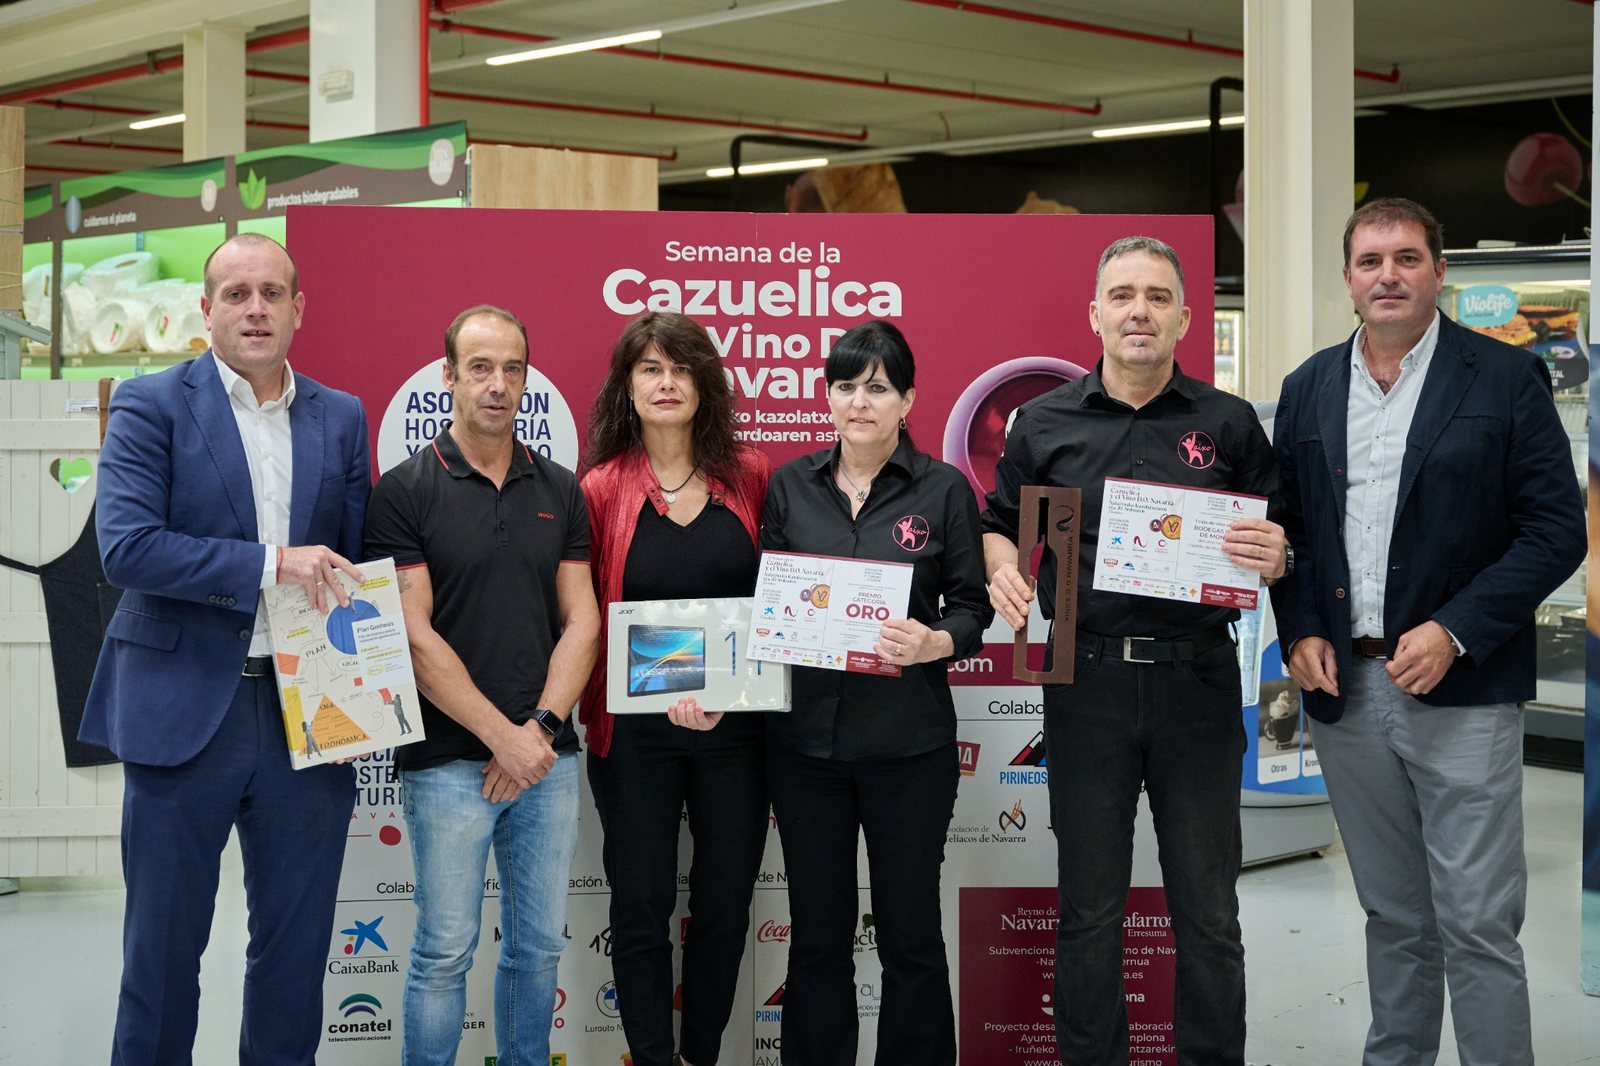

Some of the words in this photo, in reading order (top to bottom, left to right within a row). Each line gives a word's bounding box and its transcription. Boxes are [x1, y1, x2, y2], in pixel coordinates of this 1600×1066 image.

[302, 185, 359, 205] biodegradables
[665, 240, 772, 263] Semana
[779, 241, 813, 263] de
[820, 241, 841, 263] la
[602, 265, 903, 318] Cazuelica
[1464, 293, 1514, 317] Violife
[704, 322, 811, 359] Vino
[733, 428, 812, 442] ardoaren
[1194, 525, 1225, 535] BODEGAS
[1209, 533, 1226, 541] MON
[858, 591, 882, 599] PREMIO
[846, 603, 890, 621] ORO
[305, 643, 327, 658] PLAN
[987, 700, 1045, 715] Colabo
[1271, 764, 1288, 774] Otras
[999, 771, 1049, 785] PIRINEOS
[946, 825, 980, 833] sociación
[979, 834, 990, 843] de
[991, 833, 1027, 843] Navarra
[1017, 907, 1045, 918] Reyno
[1046, 906, 1057, 917] de
[756, 920, 791, 943] Coca
[1127, 928, 1168, 938] Erresuma
[989, 946, 1056, 956] Subvenciona
[1140, 945, 1155, 956] de
[328, 960, 399, 975] CaixaBank
[328, 1019, 392, 1034] conatel
[984, 1022, 1030, 1034] Proyecto
[328, 1035, 392, 1043] telecomunicaciones
[1020, 1034, 1057, 1044] Ayunta
[1015, 1044, 1056, 1054] Iruñeko
